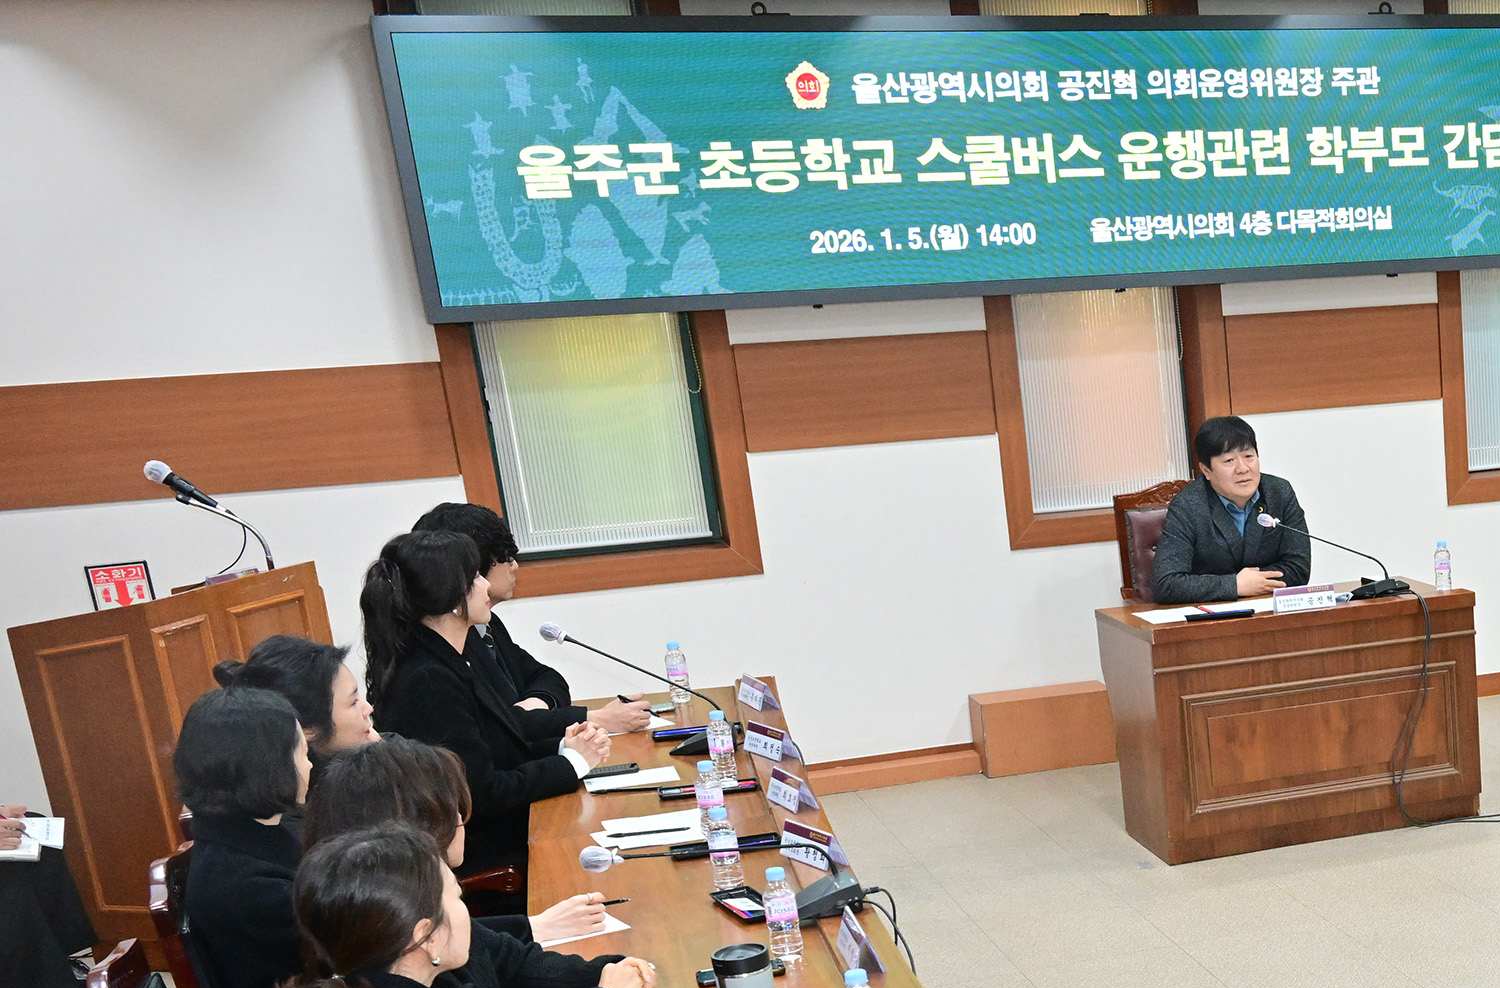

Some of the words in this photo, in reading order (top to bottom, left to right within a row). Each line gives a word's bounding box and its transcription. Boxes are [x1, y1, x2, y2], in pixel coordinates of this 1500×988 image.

[797, 79, 820, 93] 의회
[851, 70, 1049, 105] 울산광역시의회
[1057, 69, 1138, 101] 공진혁
[1146, 66, 1324, 99] 의회운영위원장
[1330, 65, 1381, 96] 주관
[516, 142, 681, 200] 울주군
[699, 137, 903, 193] 초등학교
[916, 132, 1104, 186] 스쿨버스
[1117, 127, 1290, 180] 운행관련
[1306, 125, 1429, 174] 학부모
[809, 229, 875, 254] 2026.
[880, 228, 902, 250] 1.
[907, 223, 969, 251] 5.(월)
[976, 222, 1037, 247] 14:00
[1089, 211, 1235, 243] 울산광역시의회
[1239, 210, 1273, 236] 4층
[1276, 205, 1393, 235] 다목적회의실
[94, 567, 142, 580] 소화기
